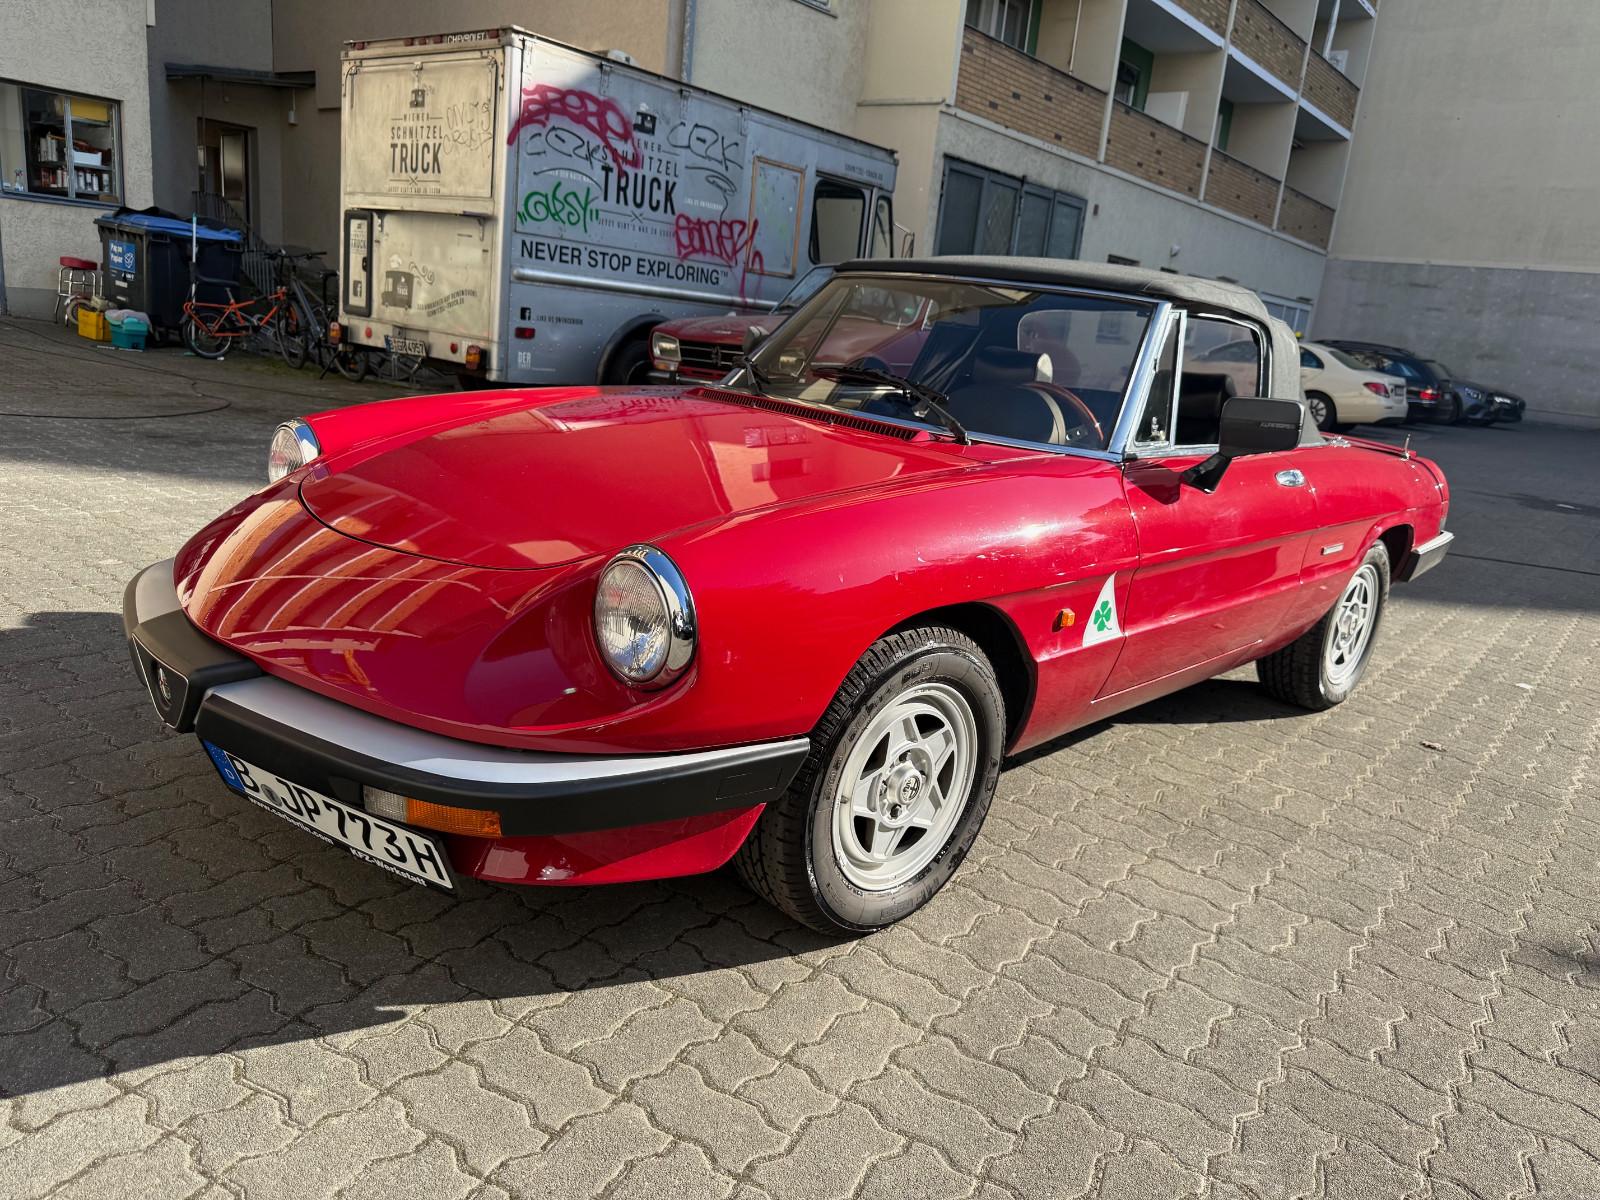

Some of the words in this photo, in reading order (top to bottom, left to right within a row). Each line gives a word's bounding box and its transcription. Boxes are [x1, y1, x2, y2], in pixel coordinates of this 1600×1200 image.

[391, 125, 443, 140] SCHNITZEL
[390, 142, 442, 174] TRUCK
[601, 165, 677, 217] TRUCK
[521, 240, 582, 265] NEVER
[587, 250, 631, 272] STOP
[230, 753, 260, 793] B
[276, 777, 321, 822] JP
[322, 800, 445, 880] 773H
